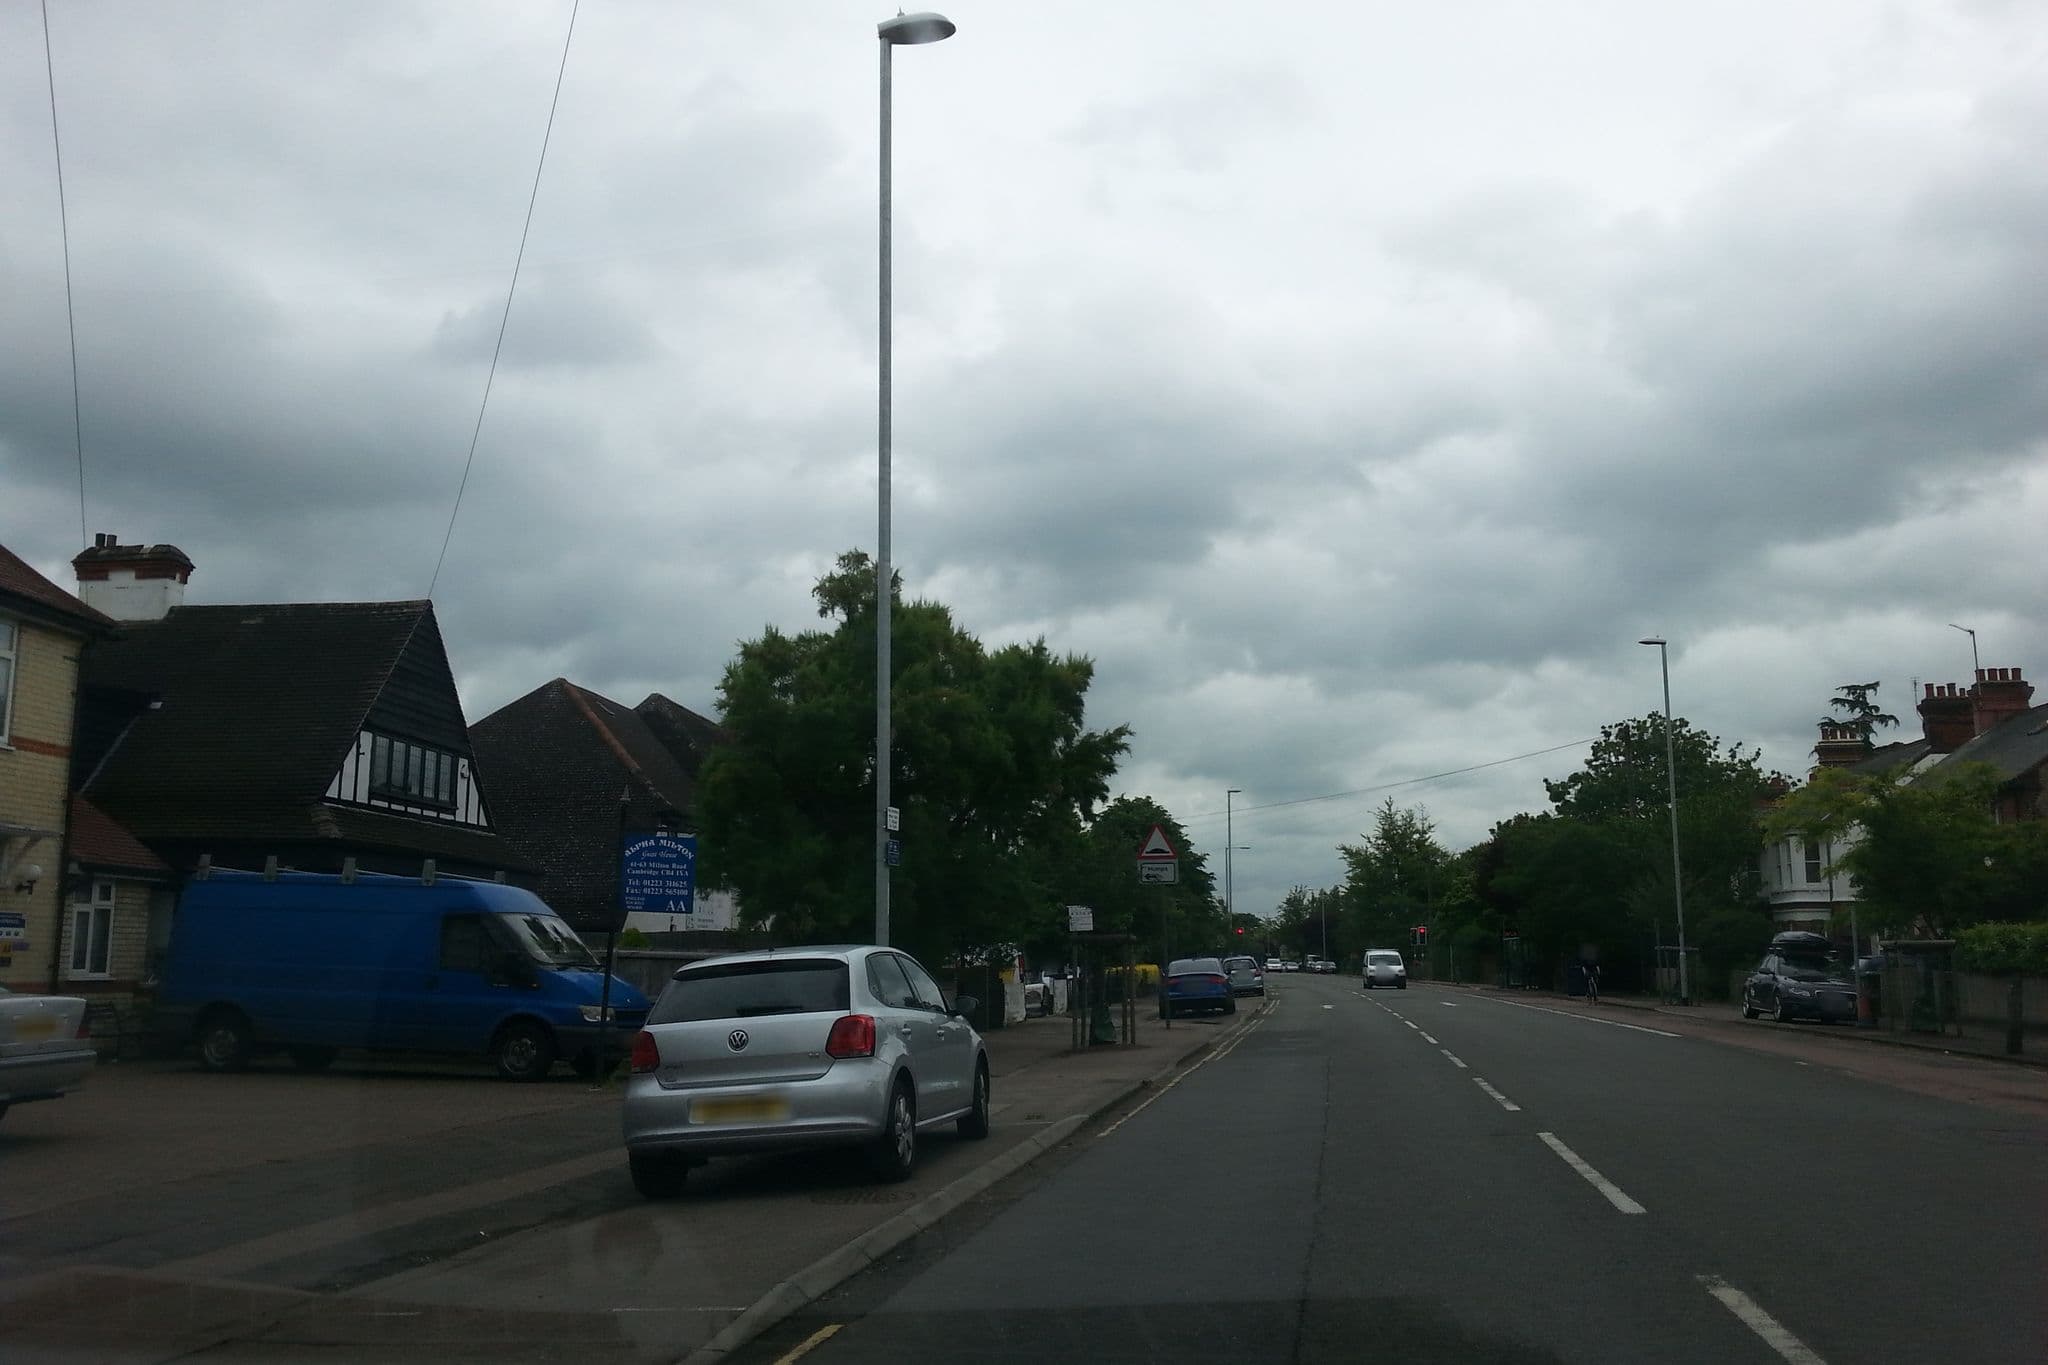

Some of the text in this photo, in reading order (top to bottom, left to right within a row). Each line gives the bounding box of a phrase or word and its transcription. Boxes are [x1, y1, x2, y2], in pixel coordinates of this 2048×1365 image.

[624, 839, 695, 860] ALPHA MILTON
[626, 868, 659, 876] Cambridge
[665, 900, 686, 912] AA
